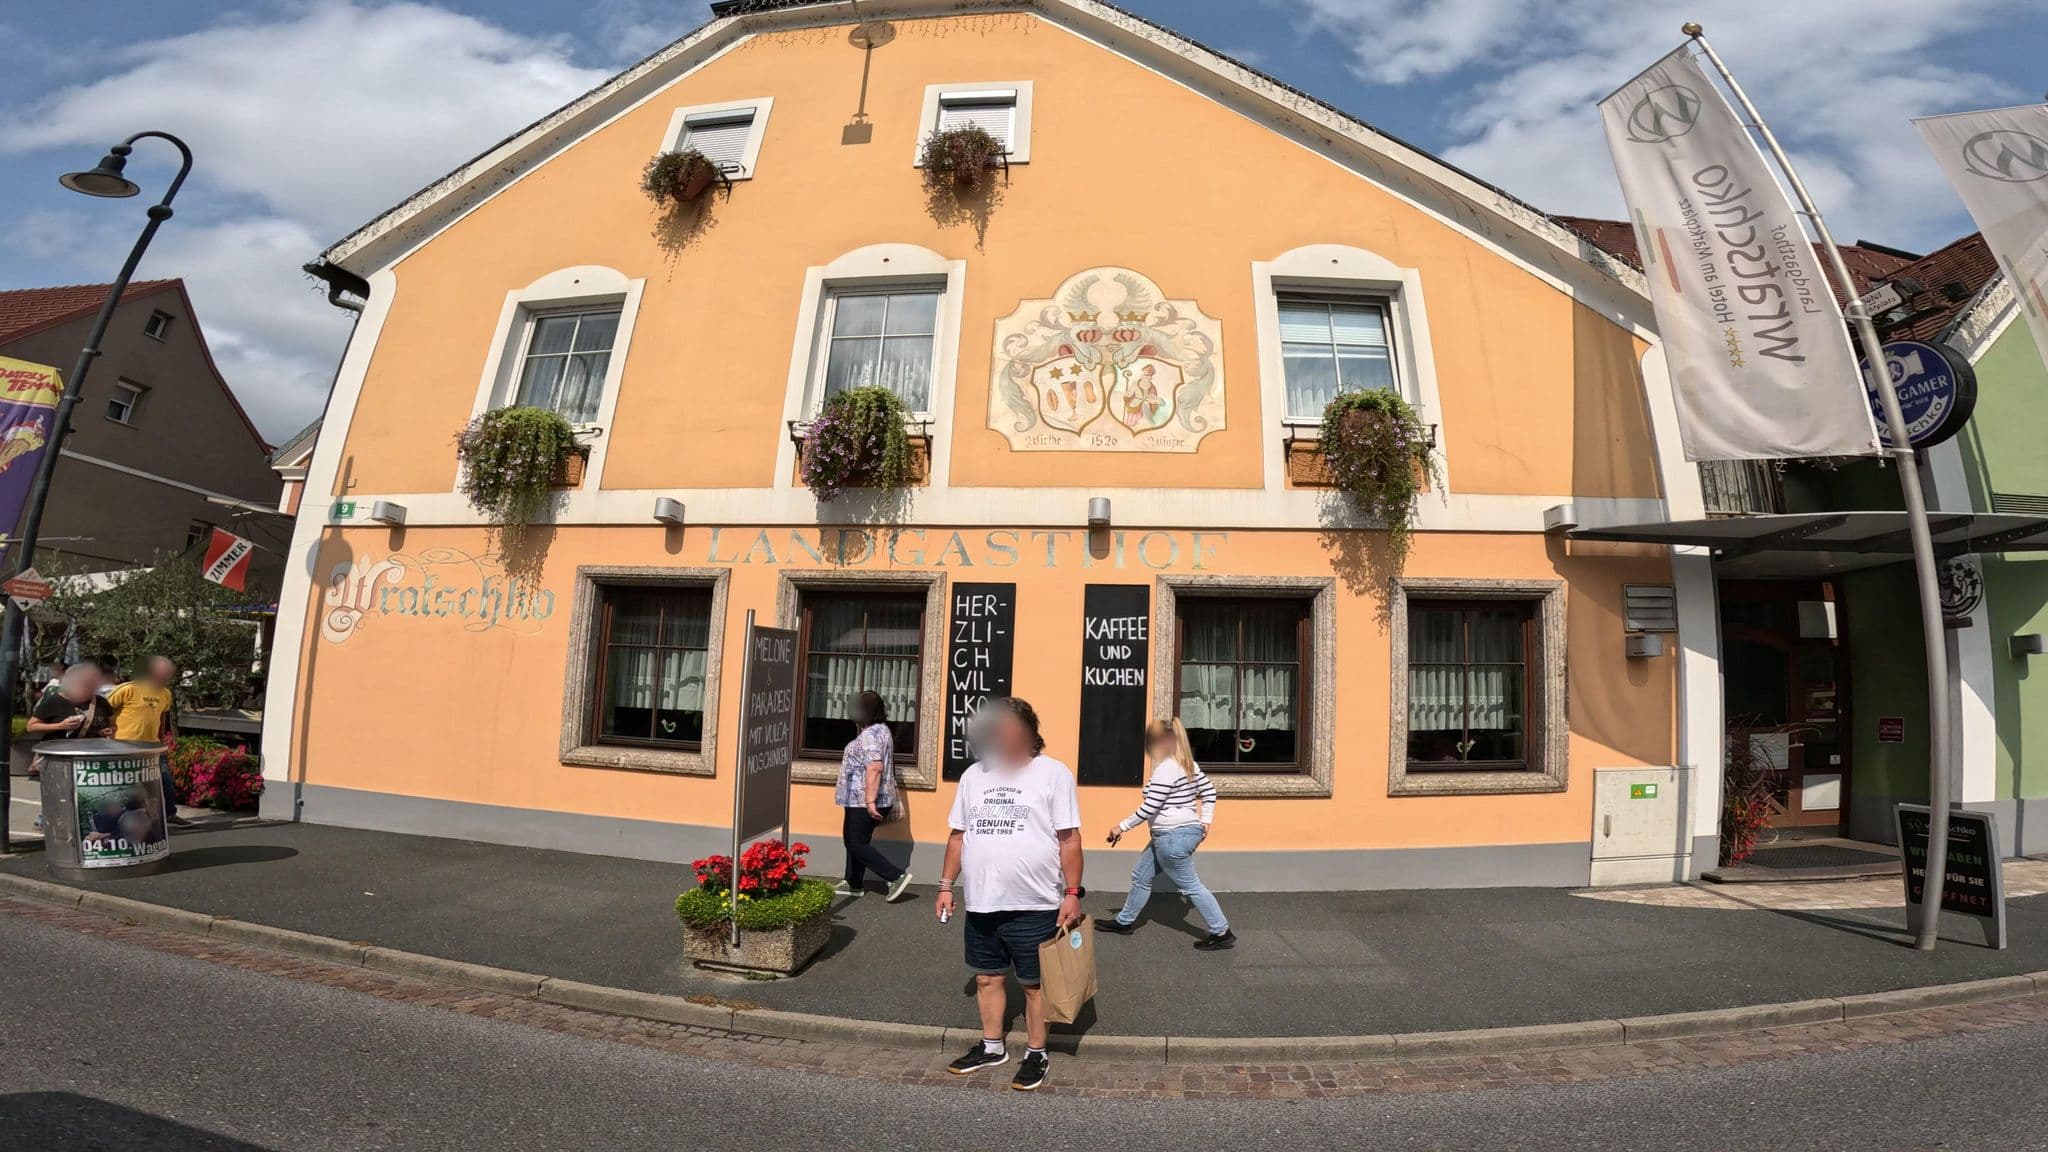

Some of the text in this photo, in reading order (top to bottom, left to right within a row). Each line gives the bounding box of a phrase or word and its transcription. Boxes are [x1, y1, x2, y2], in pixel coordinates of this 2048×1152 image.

[341, 503, 349, 514] 9
[706, 526, 1229, 571] LANDGASTHOF
[209, 542, 247, 580] ZIMMER
[955, 594, 1007, 617] HER-
[954, 620, 1005, 643] ZLI-
[1085, 616, 1148, 641] KAFFEE
[753, 637, 791, 664] MELONE
[1099, 645, 1132, 660] UND
[1085, 666, 1145, 686] KUCHEN
[750, 688, 791, 717] PARADEIS
[76, 760, 100, 770] Die
[976, 819, 1017, 828] GENUINE
[83, 839, 132, 852] 04.10.
[1946, 872, 1985, 886] FÜR SIE
